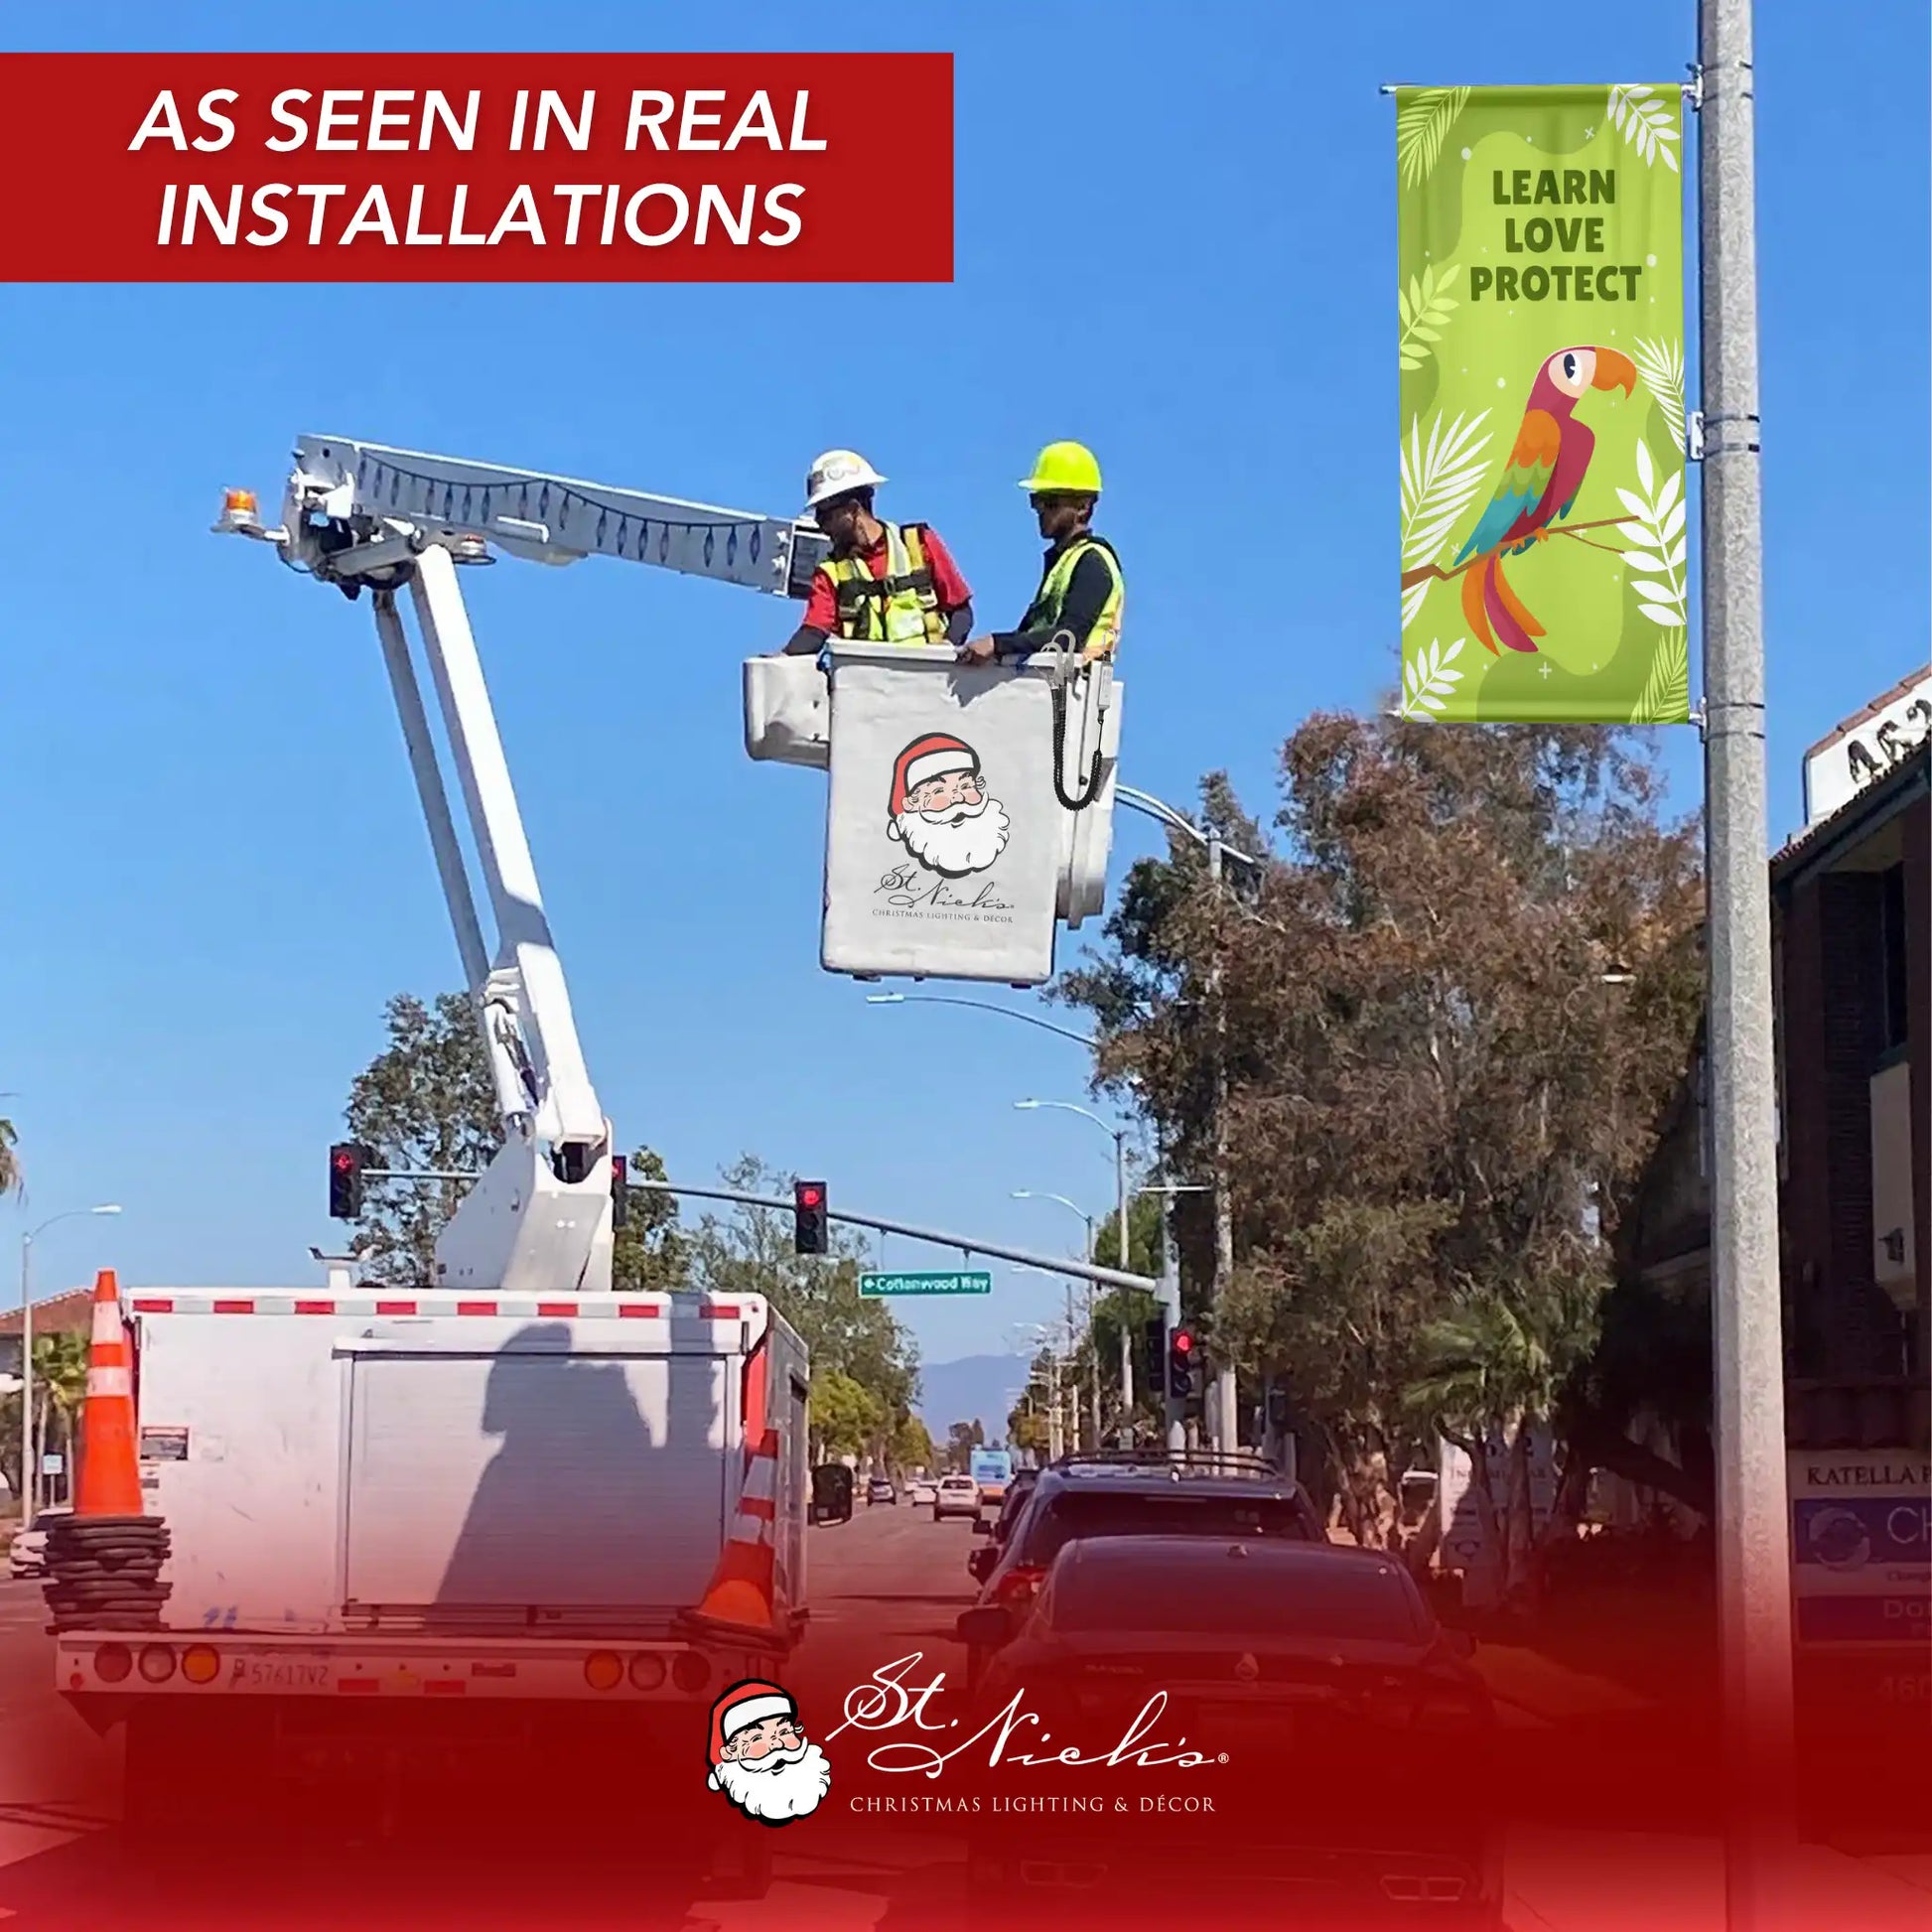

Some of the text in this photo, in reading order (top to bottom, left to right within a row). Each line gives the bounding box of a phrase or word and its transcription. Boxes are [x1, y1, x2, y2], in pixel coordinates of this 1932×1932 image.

[1493, 169, 1615, 205] LEARN
[1505, 217, 1604, 252] LOVE
[1470, 266, 1642, 302] PROTECT
[874, 864, 921, 893] St.
[872, 908, 923, 919] CHRISTMAS
[927, 911, 971, 921] LIGHTING
[1807, 1465, 1914, 1485] KATELLA
